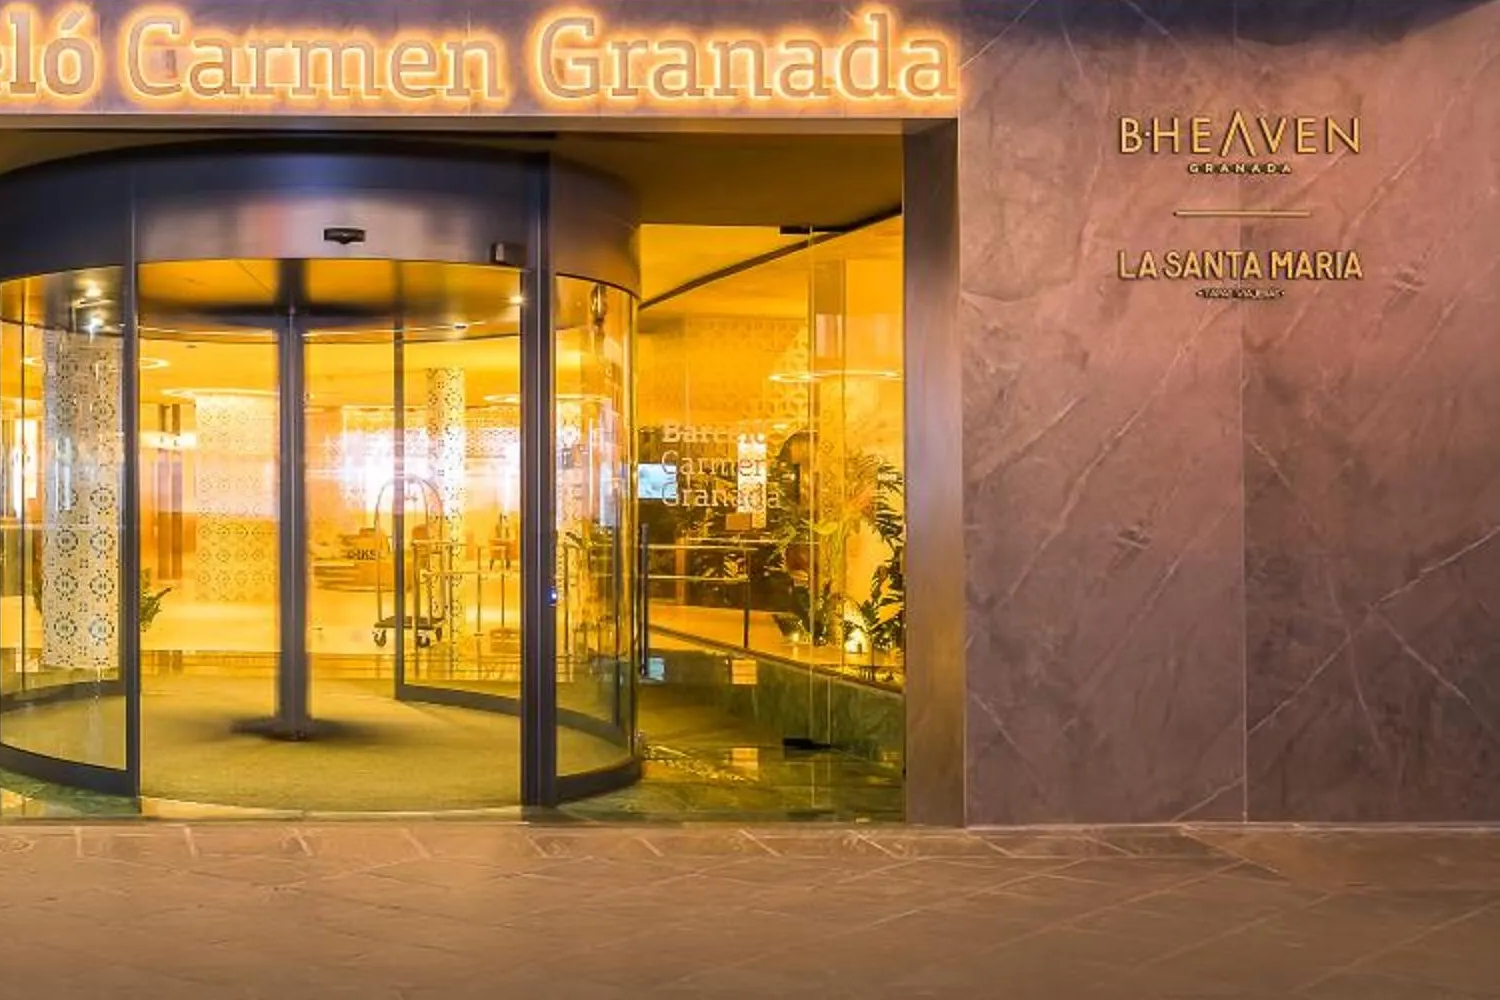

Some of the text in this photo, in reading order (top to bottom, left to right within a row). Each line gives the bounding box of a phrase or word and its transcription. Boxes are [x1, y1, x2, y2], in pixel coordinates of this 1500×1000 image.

[128, 15, 501, 97] Carmen
[538, 13, 957, 99] Granada
[1188, 163, 1292, 175] GRANADA
[1118, 251, 1363, 279] LA SANTA MARIA
